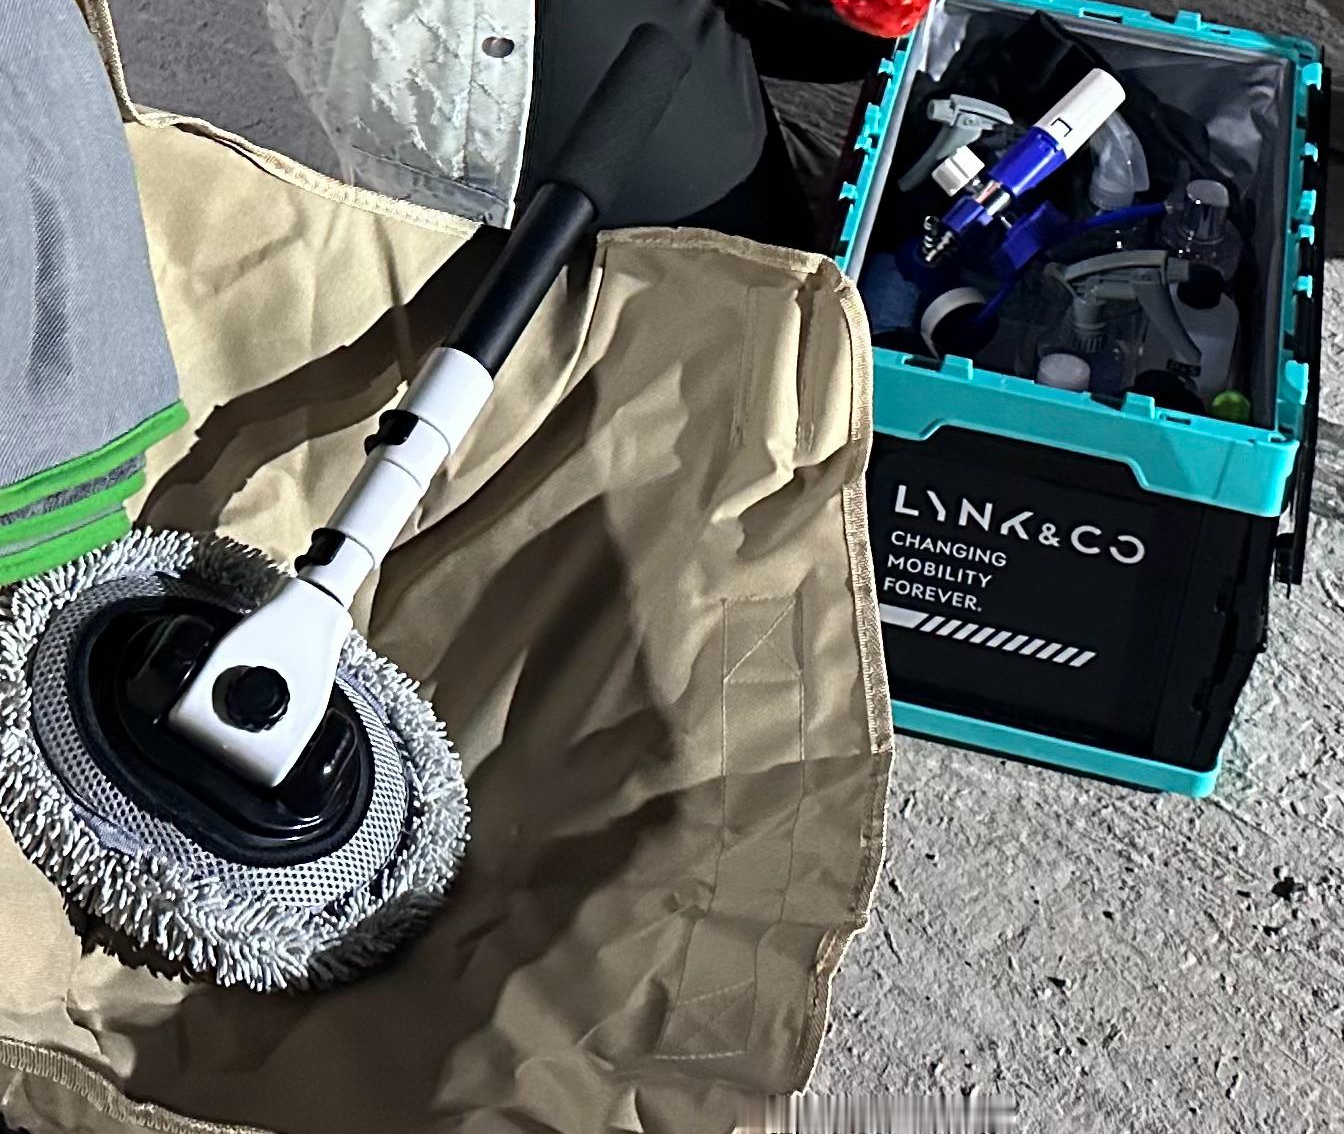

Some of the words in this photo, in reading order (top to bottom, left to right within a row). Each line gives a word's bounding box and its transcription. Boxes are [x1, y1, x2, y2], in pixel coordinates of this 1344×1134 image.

[894, 484, 1145, 564] LYNK&CO
[891, 530, 1007, 567] CHANGING
[887, 553, 992, 588] MOBILITY
[883, 576, 982, 612] FOREVER.
